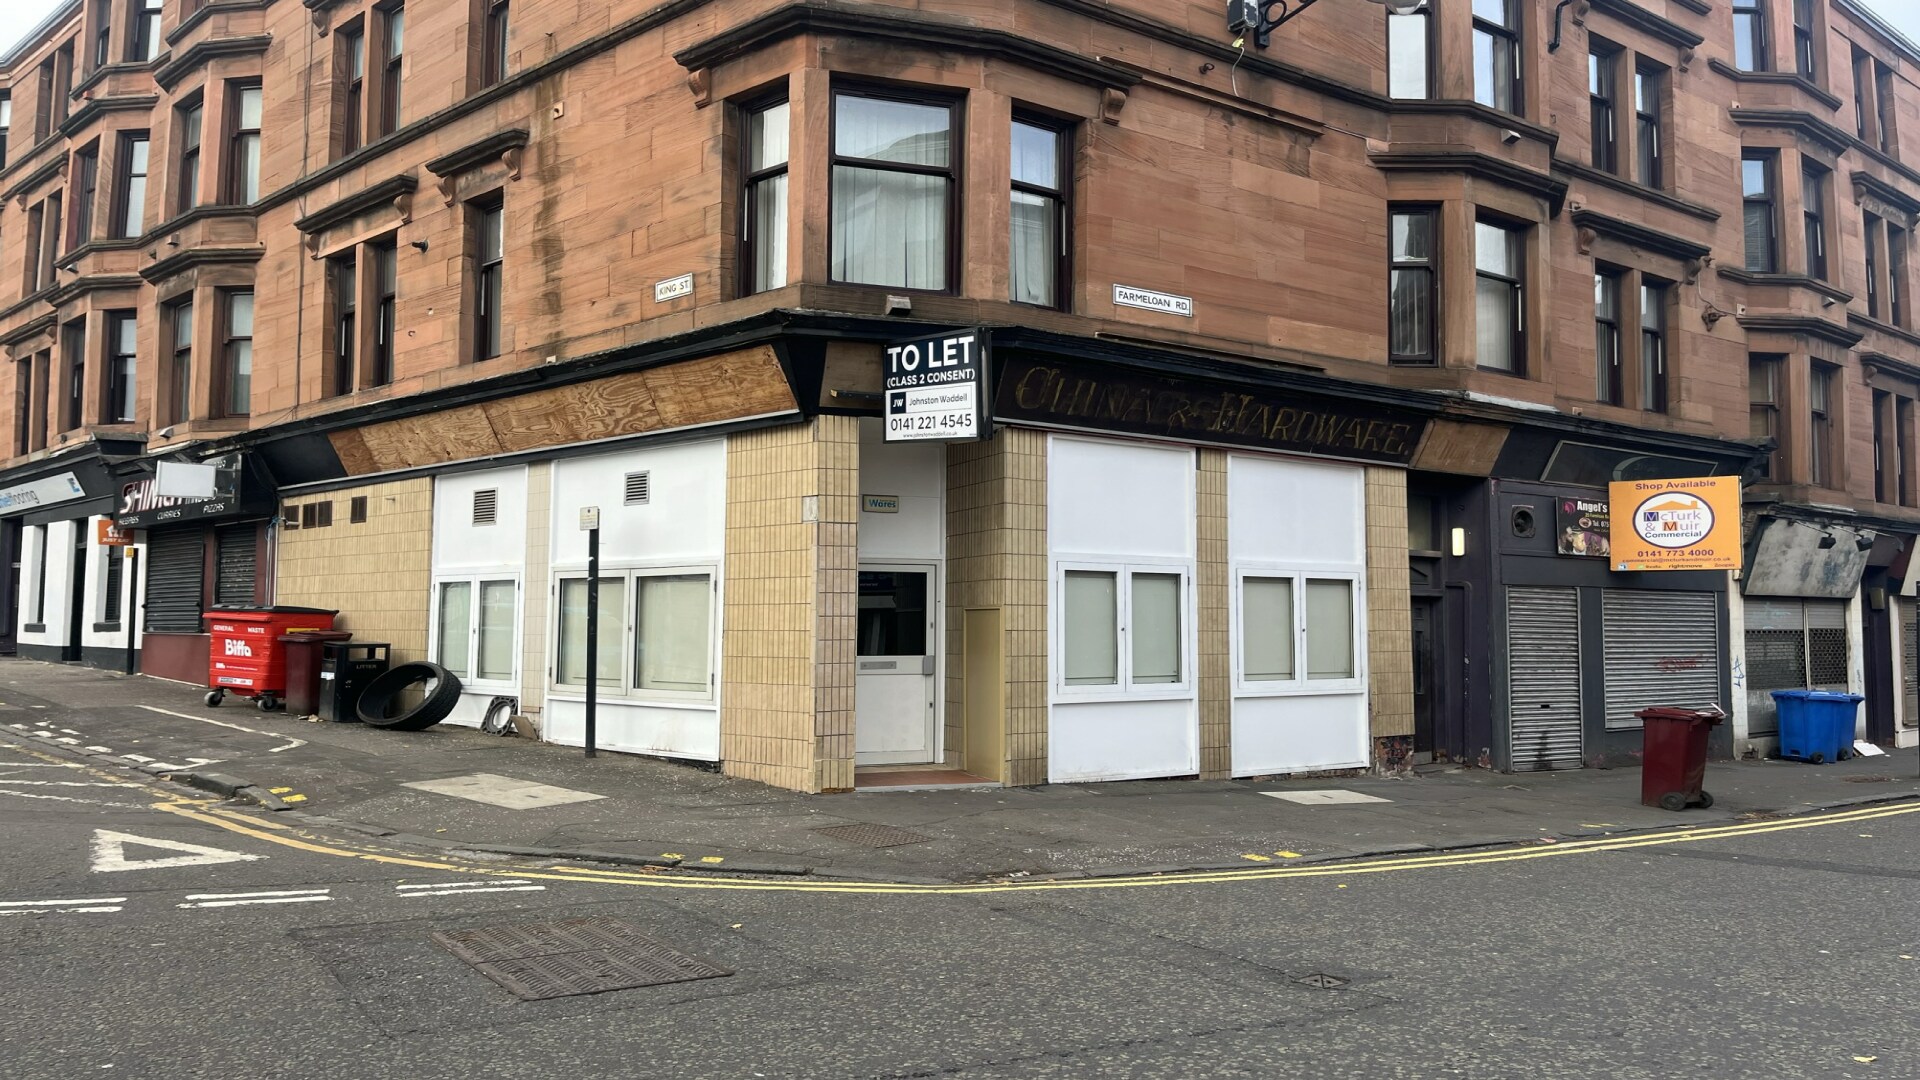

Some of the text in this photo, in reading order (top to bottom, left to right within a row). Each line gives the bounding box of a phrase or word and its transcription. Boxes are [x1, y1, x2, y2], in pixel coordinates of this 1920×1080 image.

[659, 283, 676, 296] KING
[1118, 291, 1171, 307] FARMELOAN
[887, 335, 975, 373] TO LET
[886, 368, 976, 388] (CLASS 2 CONSENT)
[892, 398, 904, 408] JW
[909, 392, 968, 407] Johnston Waddell
[890, 413, 972, 432] 0141 221 4545
[1635, 480, 1716, 491] Shop Available
[157, 509, 181, 521] CURRIES
[202, 502, 225, 514] PIZZAS
[1577, 501, 1608, 513] Angel's
[1643, 510, 1702, 522] McTurk
[1645, 521, 1700, 531] & Muir
[1644, 531, 1702, 539] Commercial
[213, 624, 234, 632] GENERAL
[224, 638, 252, 657] Biffa
